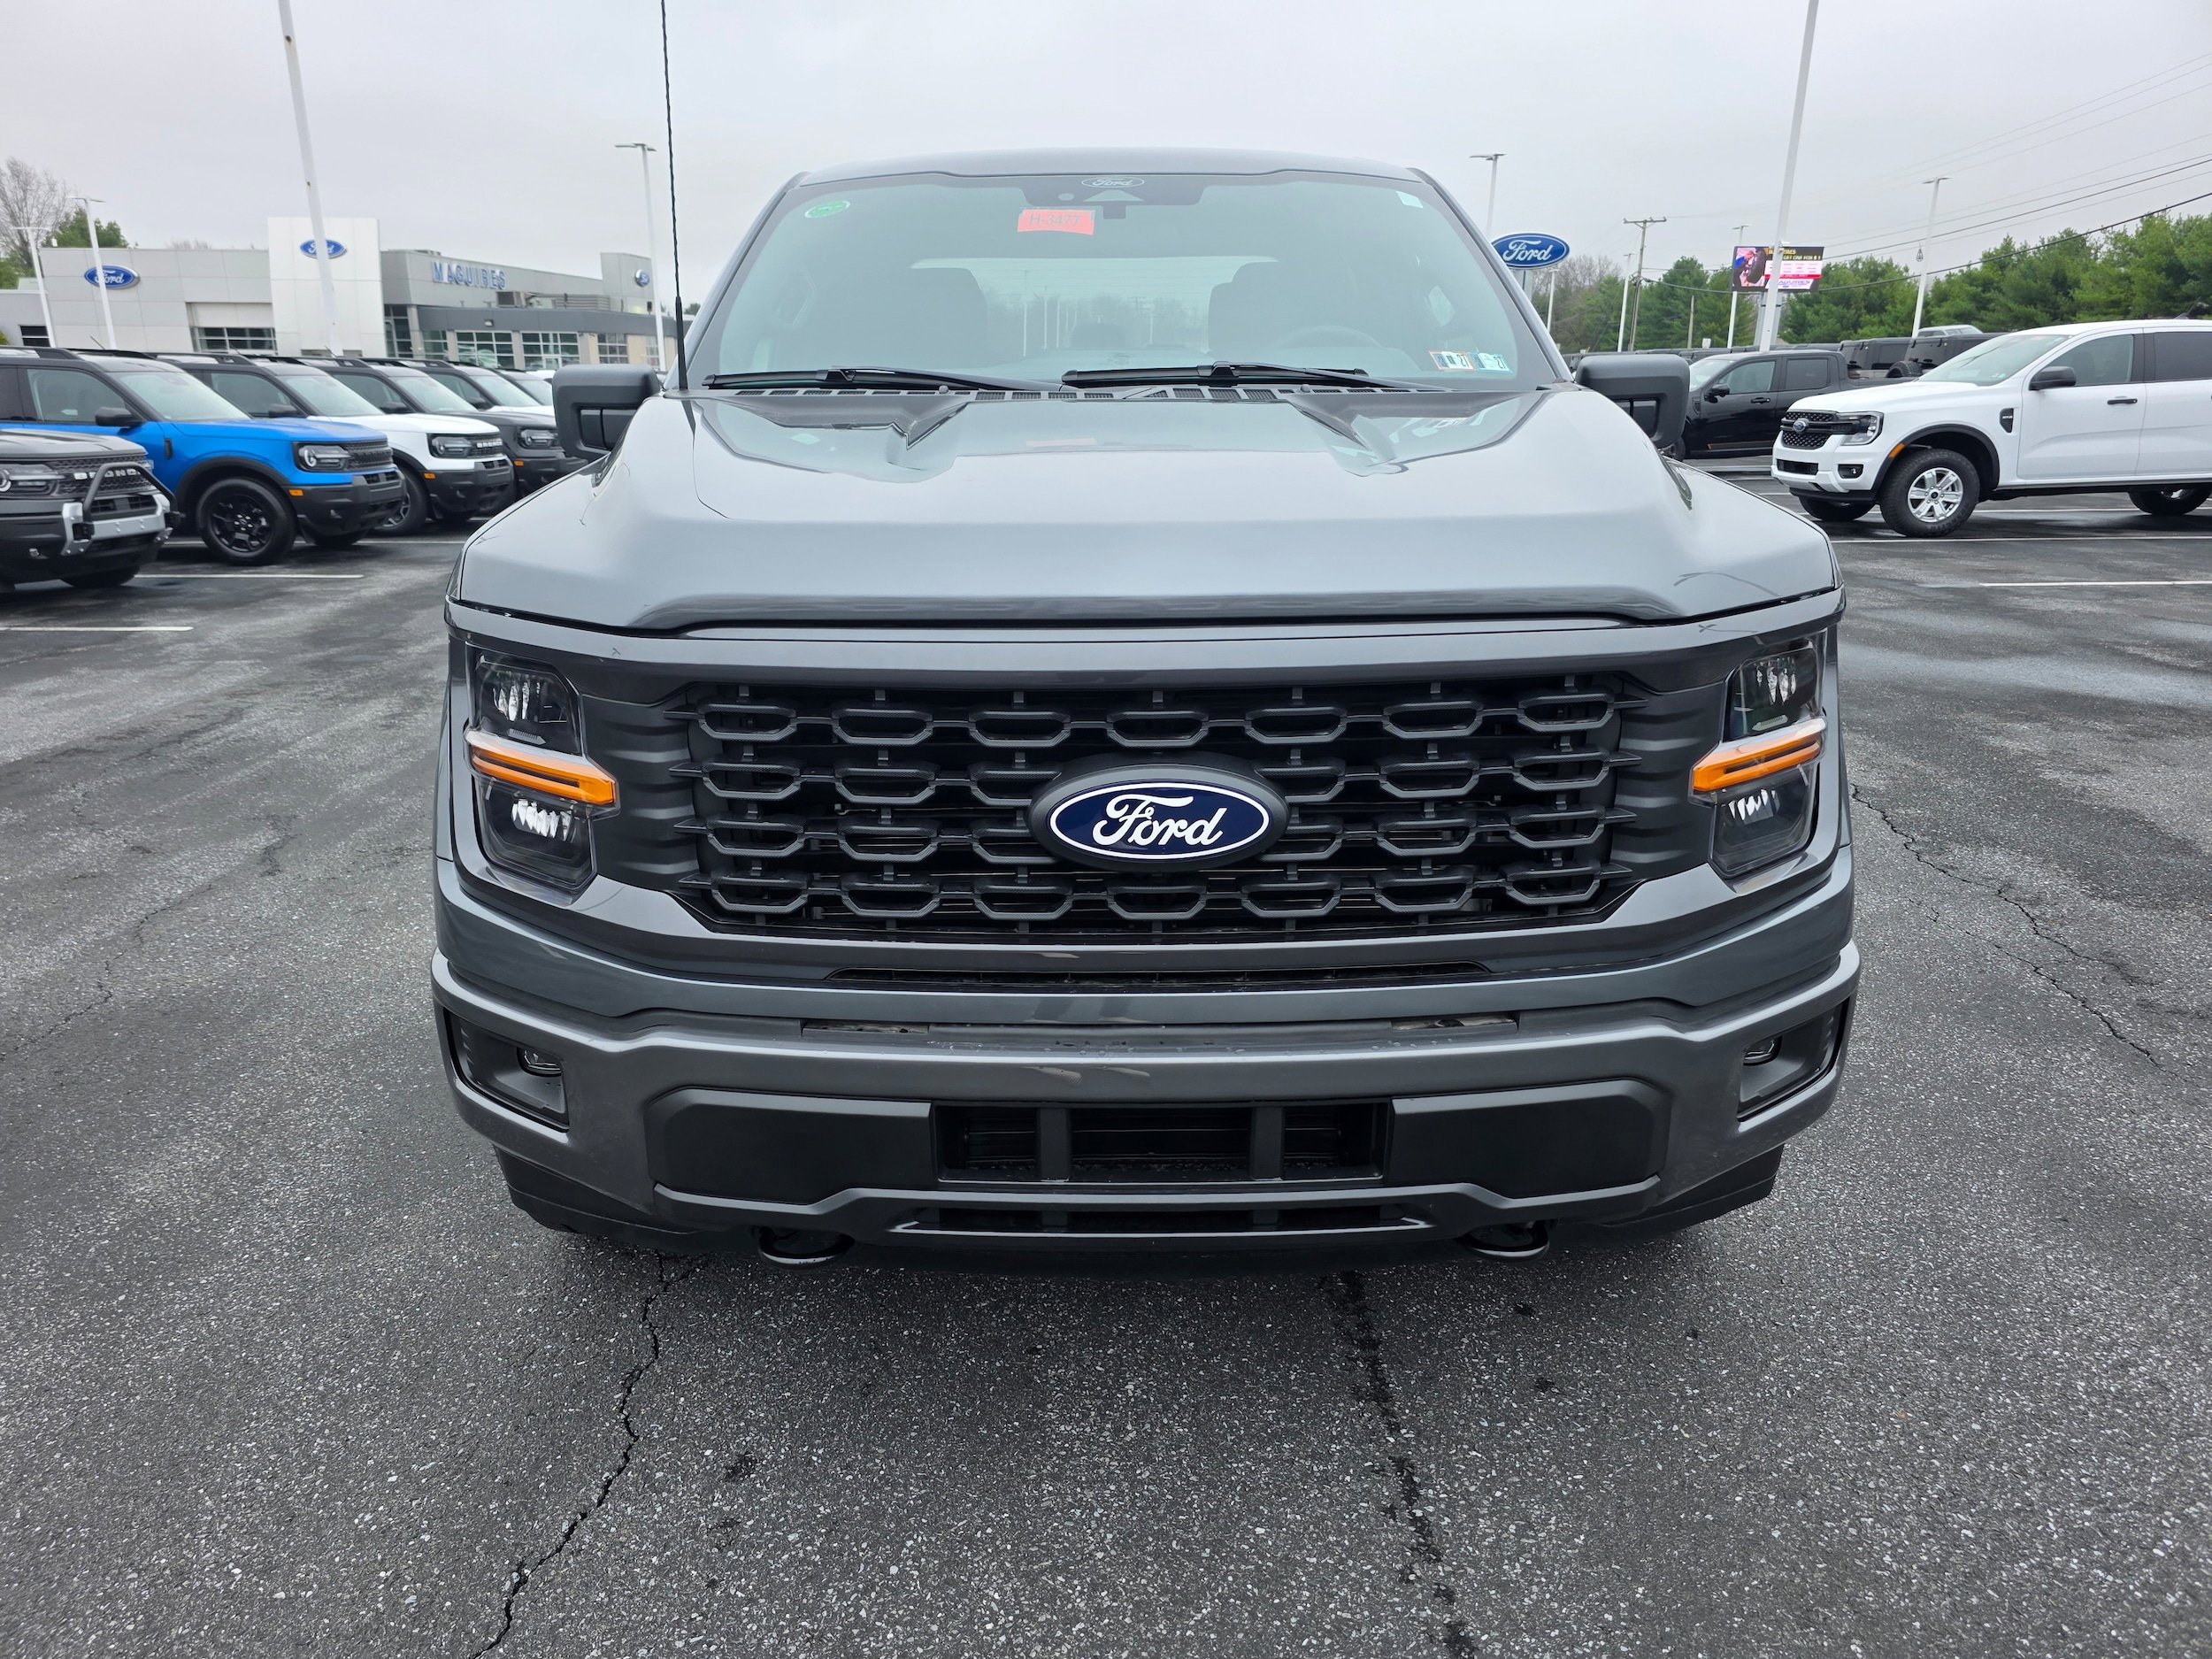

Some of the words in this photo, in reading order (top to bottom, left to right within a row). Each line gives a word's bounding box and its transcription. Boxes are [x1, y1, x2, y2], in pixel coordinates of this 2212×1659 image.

[1502, 239, 1554, 261] Ford
[432, 261, 507, 289] MAGUIRES
[1092, 794, 1227, 846] Ford
